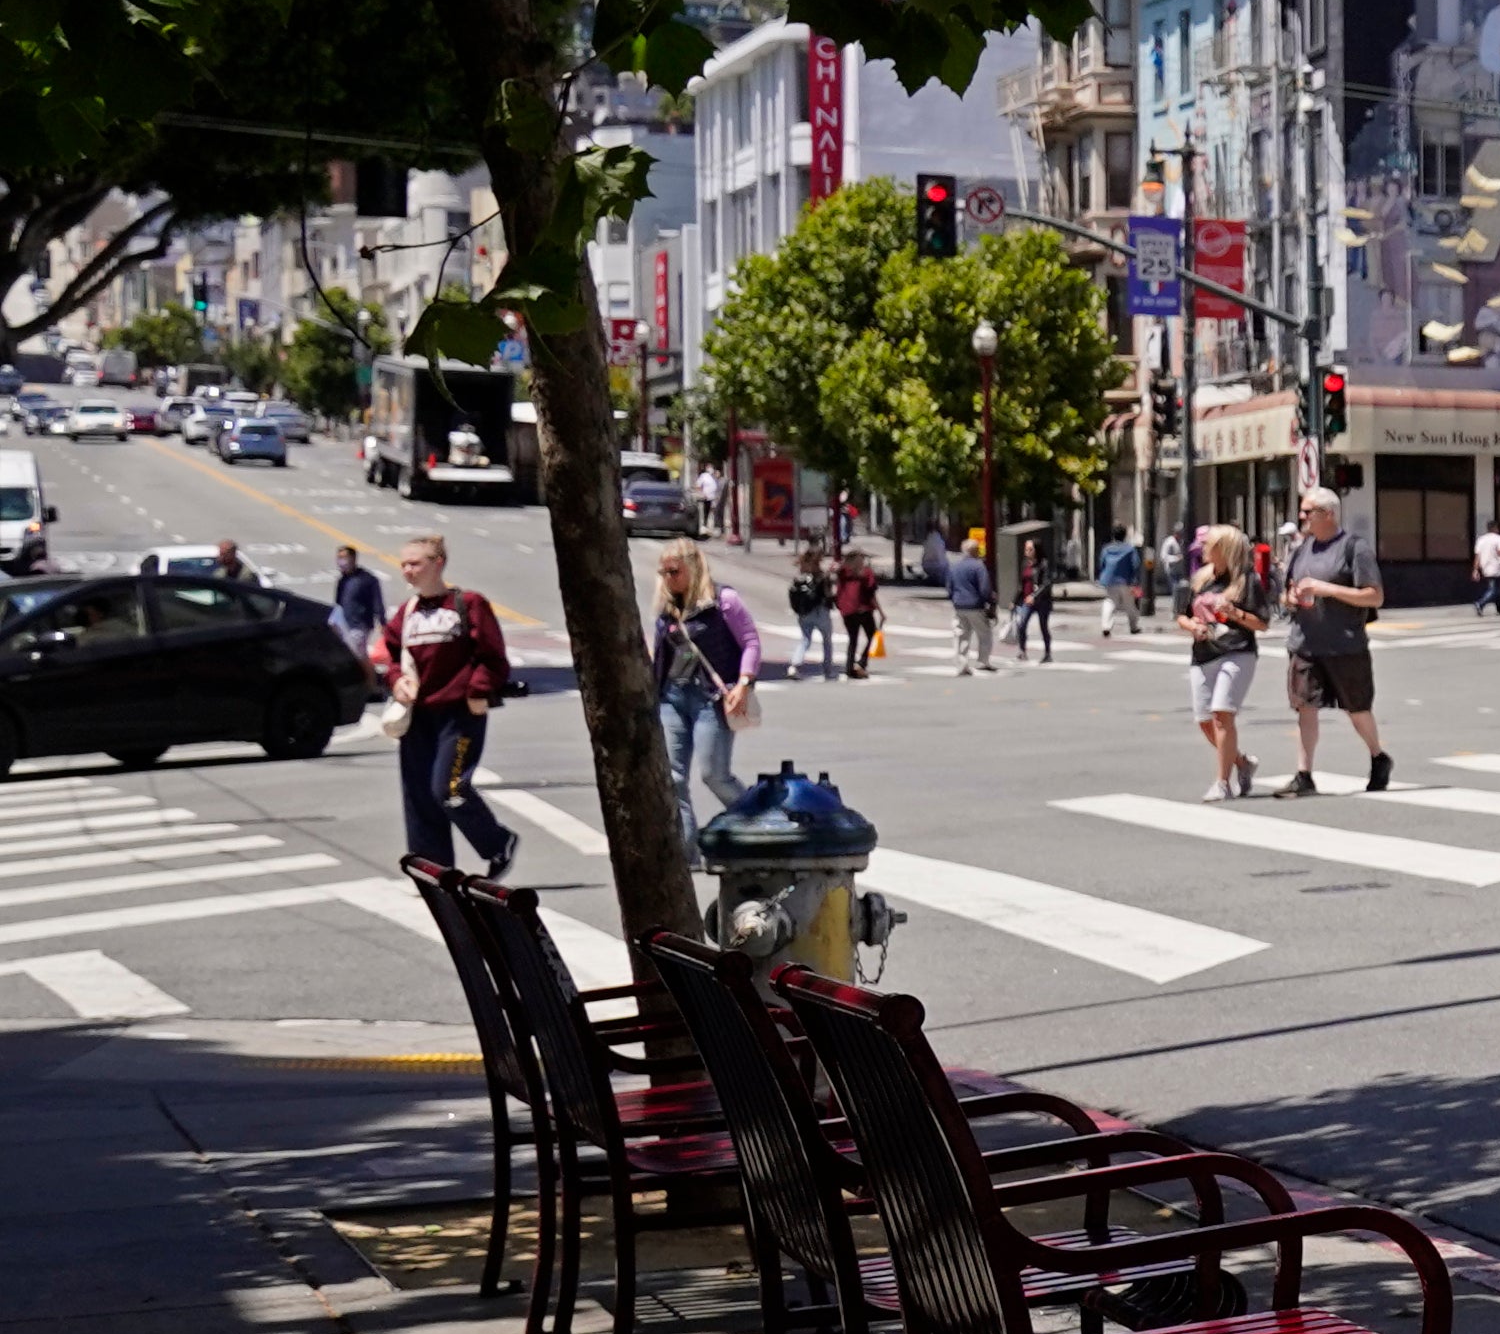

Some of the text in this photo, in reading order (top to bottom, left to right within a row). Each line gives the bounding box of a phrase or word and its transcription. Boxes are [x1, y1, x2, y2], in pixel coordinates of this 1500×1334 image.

[1142, 258, 1172, 276] 25
[1385, 429, 1415, 444] New
[1420, 431, 1448, 445] Sun
[1452, 431, 1490, 448] Hong
